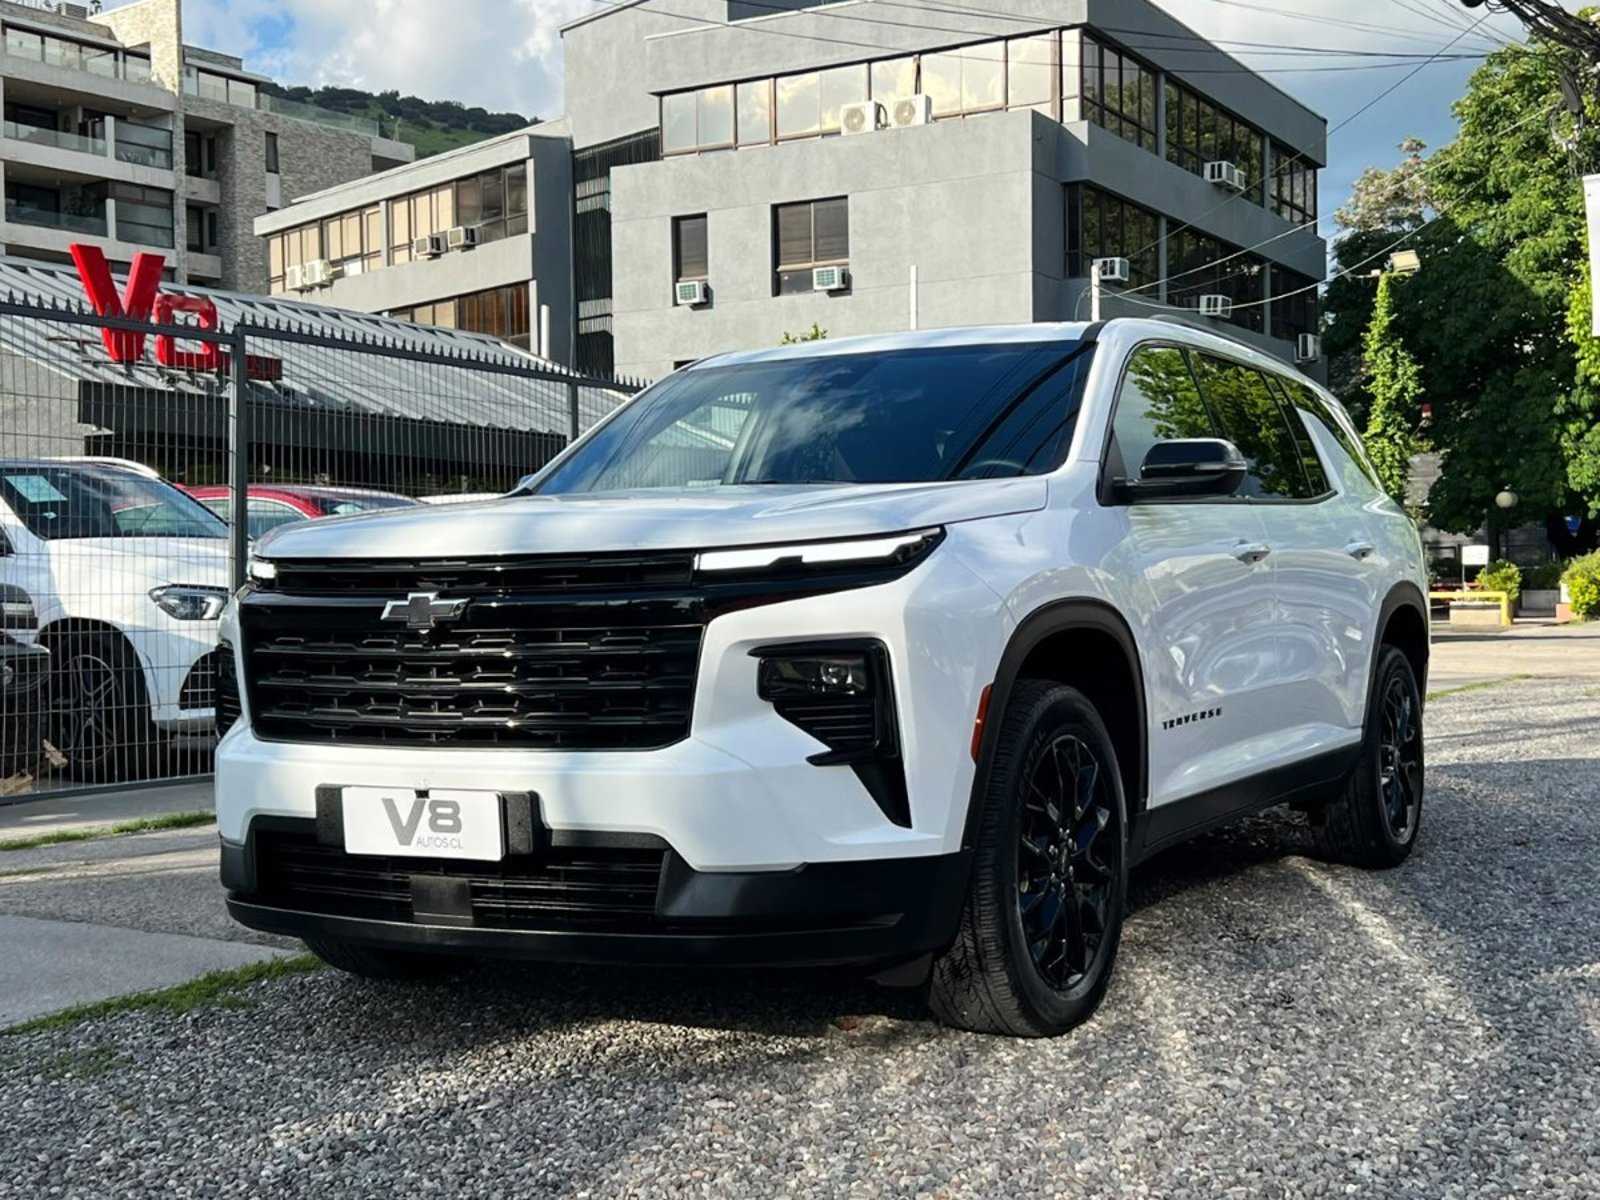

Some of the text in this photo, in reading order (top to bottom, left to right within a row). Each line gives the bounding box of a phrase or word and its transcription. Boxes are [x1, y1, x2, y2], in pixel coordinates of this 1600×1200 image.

[69, 243, 220, 370] V8
[1162, 706, 1222, 730] TRAVERSE
[381, 798, 463, 846] V8
